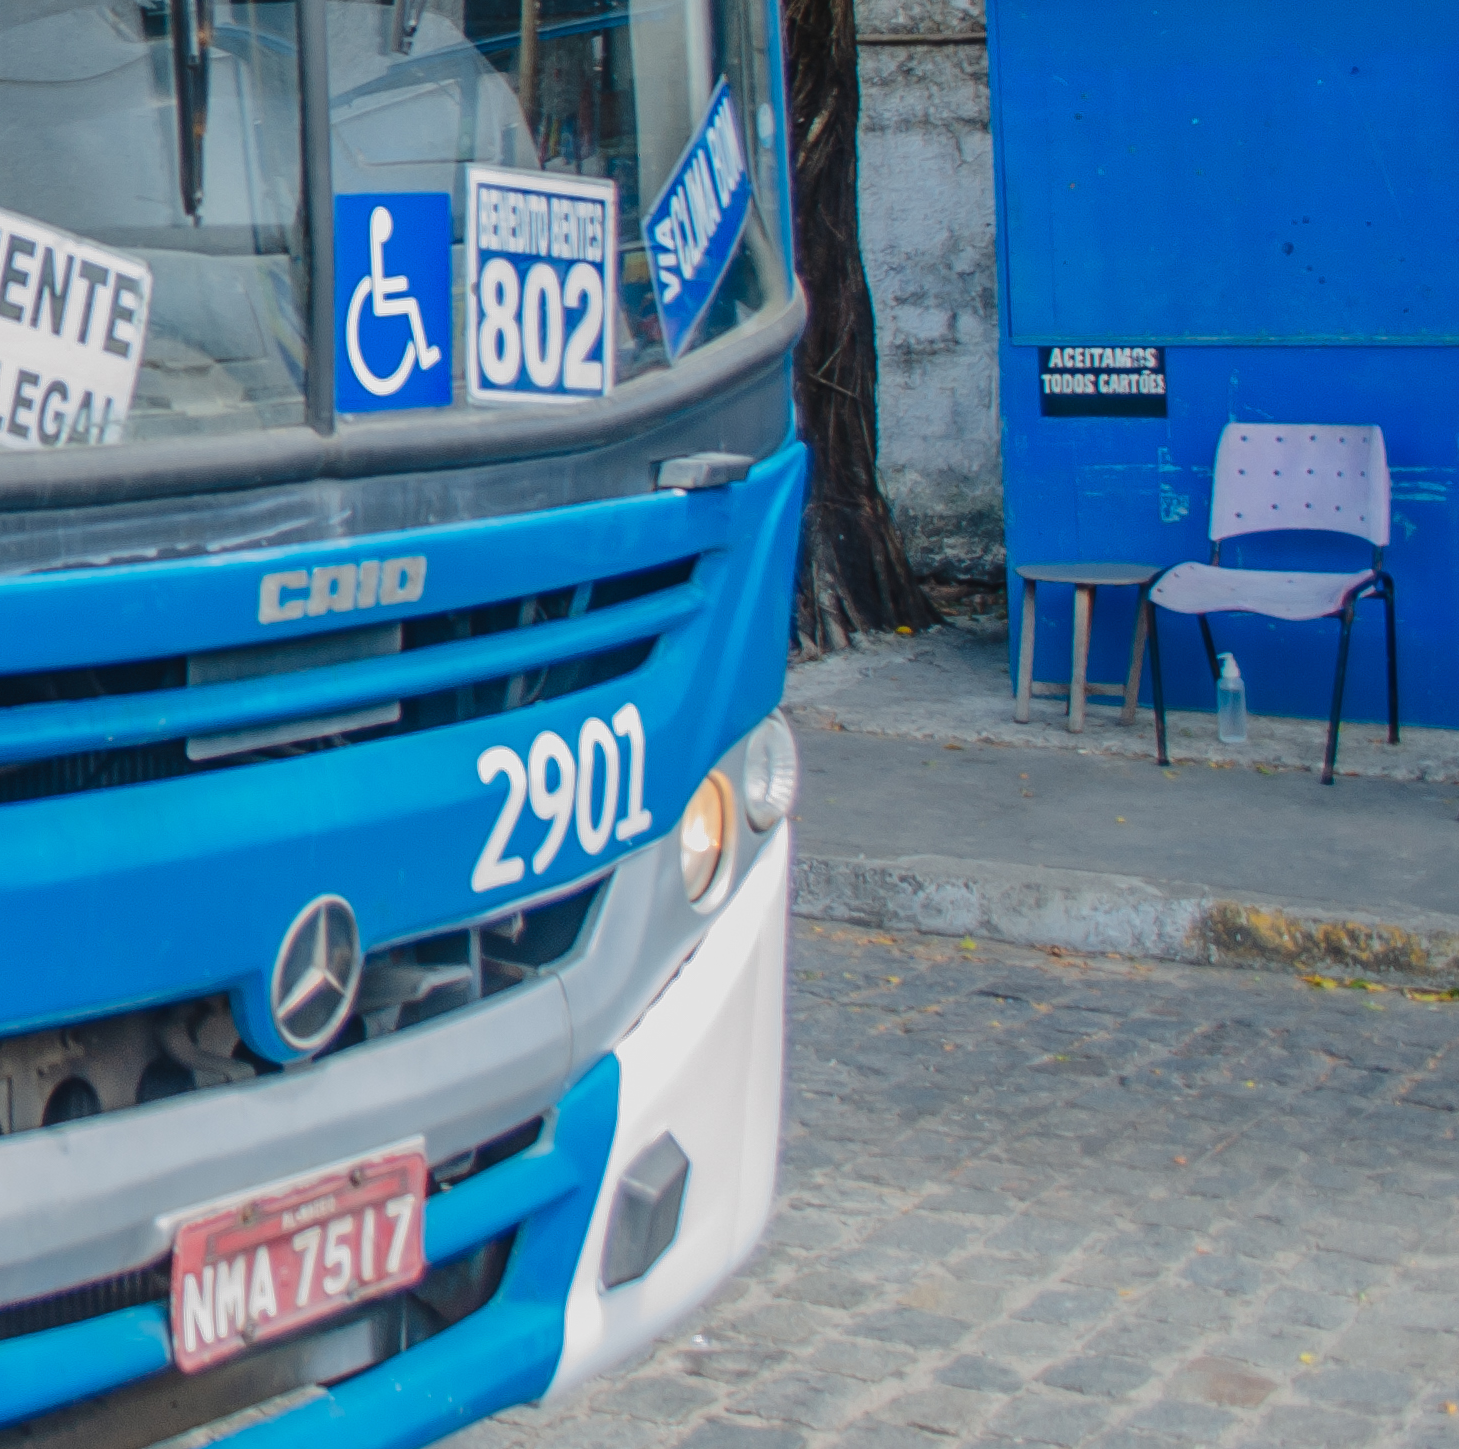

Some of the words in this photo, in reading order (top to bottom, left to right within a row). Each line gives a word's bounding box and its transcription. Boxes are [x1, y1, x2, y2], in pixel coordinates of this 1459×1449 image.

[478, 186, 548, 258] BENEDITO
[550, 196, 603, 264] BENTES
[654, 216, 682, 304] VIA
[479, 256, 604, 391] 802
[1047, 347, 1159, 369] ACEITAMOS
[1040, 373, 1097, 394] TODOS
[1098, 369, 1167, 394] CARTÕES
[258, 555, 428, 625] CAIO
[470, 701, 653, 894] 2901
[183, 1244, 278, 1353] NMA
[292, 1193, 416, 1307] 7517
